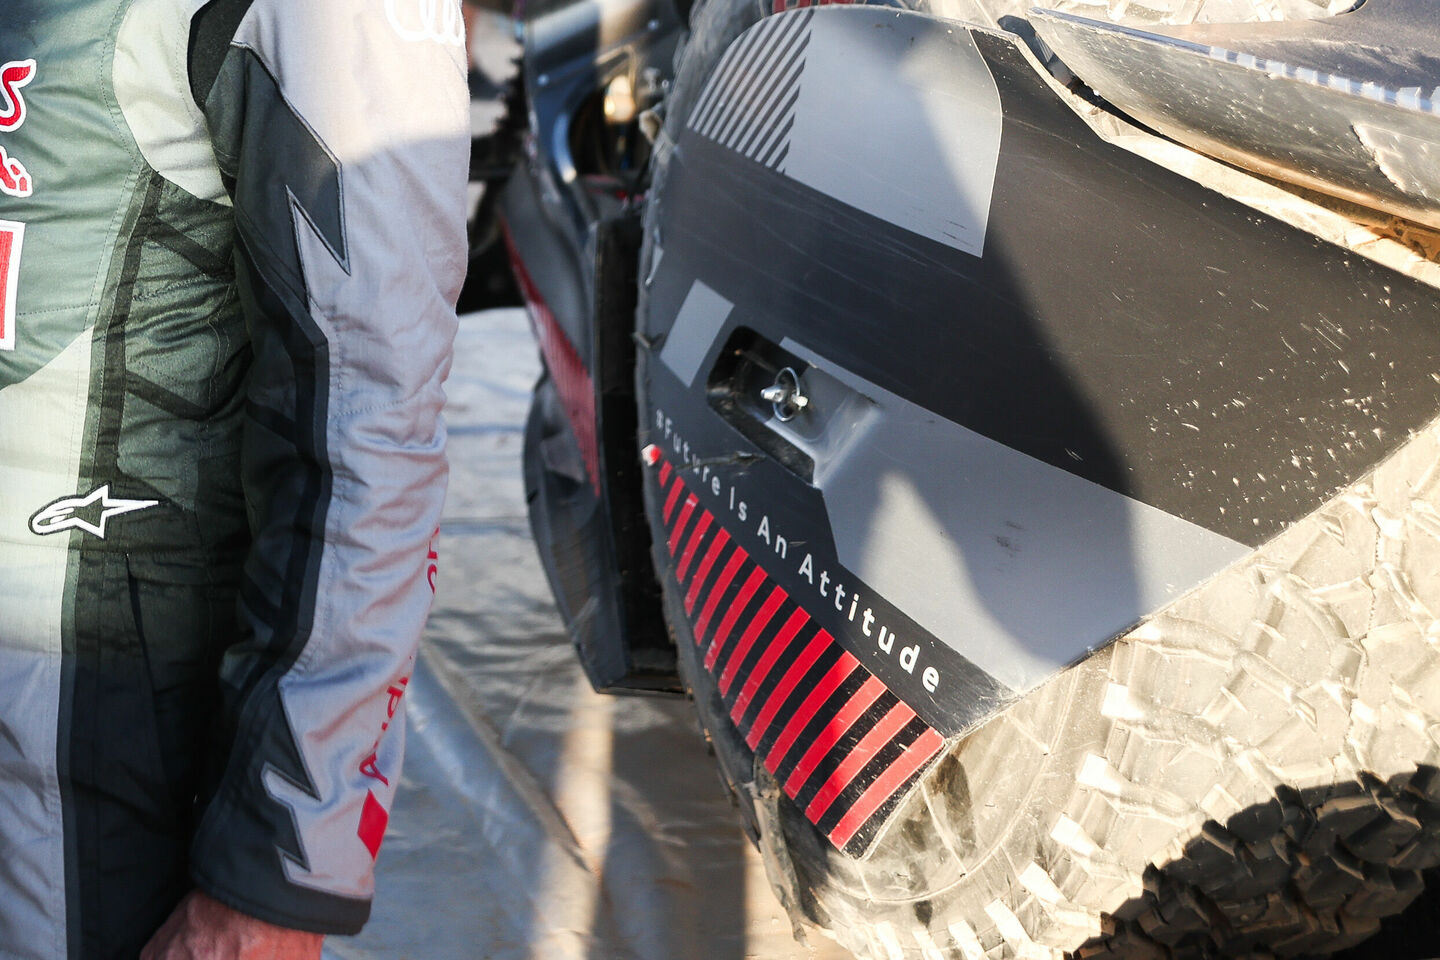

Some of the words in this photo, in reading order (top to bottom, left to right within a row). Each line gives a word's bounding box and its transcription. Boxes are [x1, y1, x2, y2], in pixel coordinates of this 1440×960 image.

[728, 486, 748, 522] Is
[757, 515, 787, 559] An
[798, 553, 940, 693] Attitude
